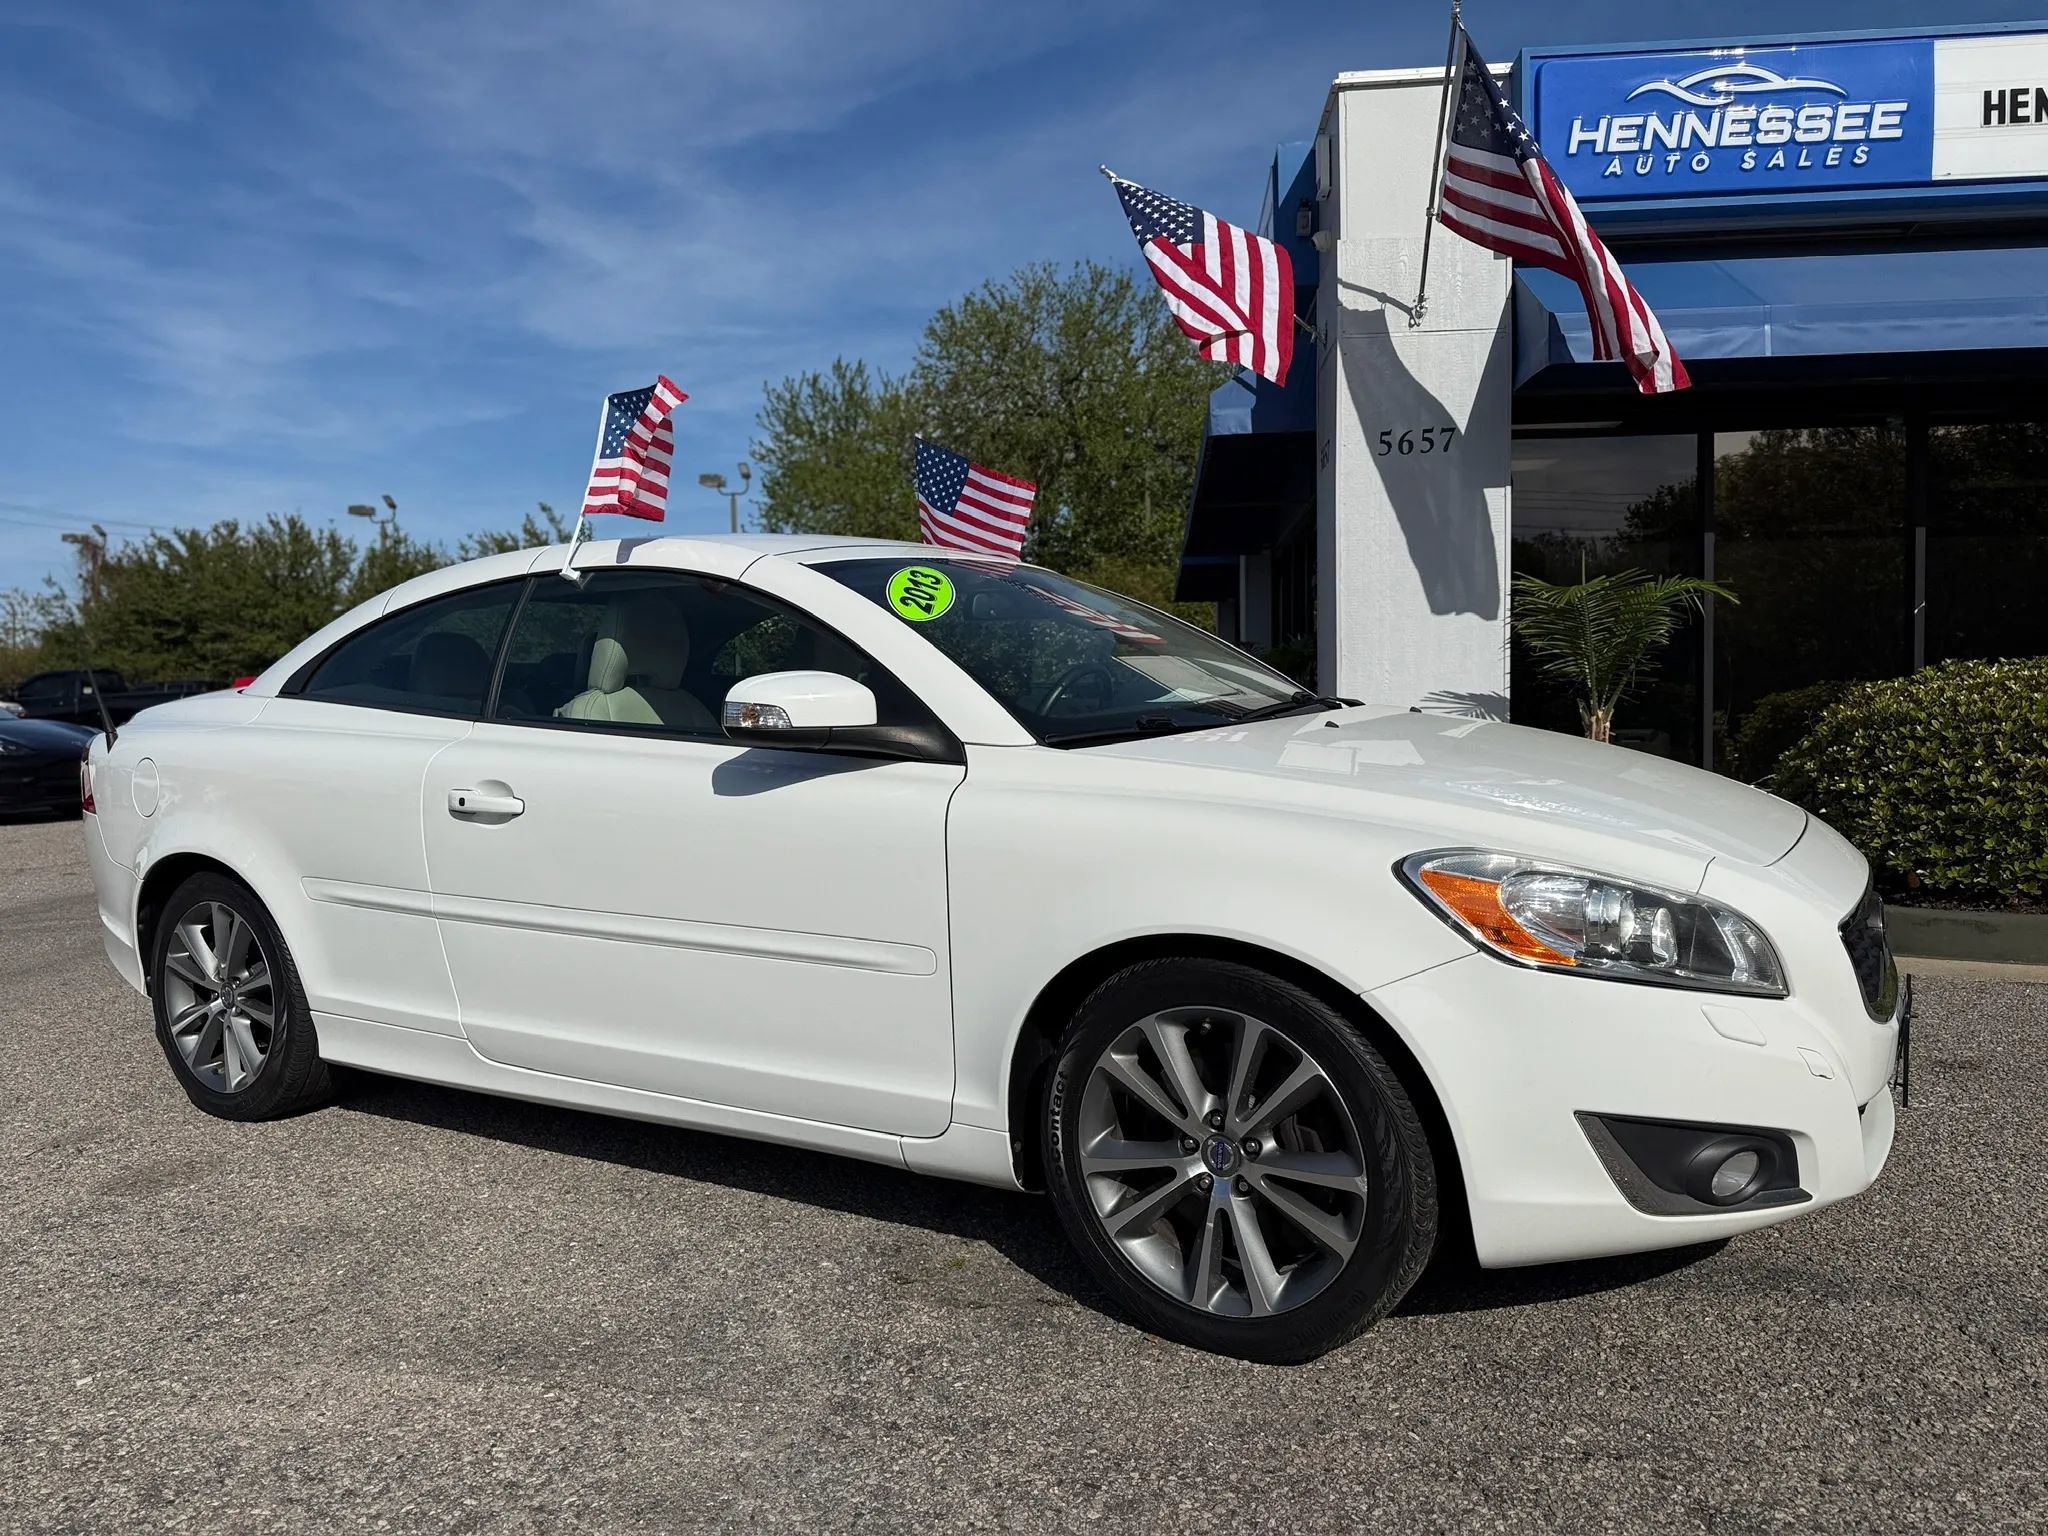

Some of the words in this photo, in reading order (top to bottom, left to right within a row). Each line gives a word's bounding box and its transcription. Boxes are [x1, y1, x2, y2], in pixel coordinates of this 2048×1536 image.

[1982, 87, 2048, 126] HEN
[1567, 101, 1909, 155] HENNESSEE
[1604, 151, 1710, 177] AUTO
[1740, 145, 1870, 170] SALES
[1377, 427, 1457, 456] 5657
[899, 569, 943, 616] 2013
